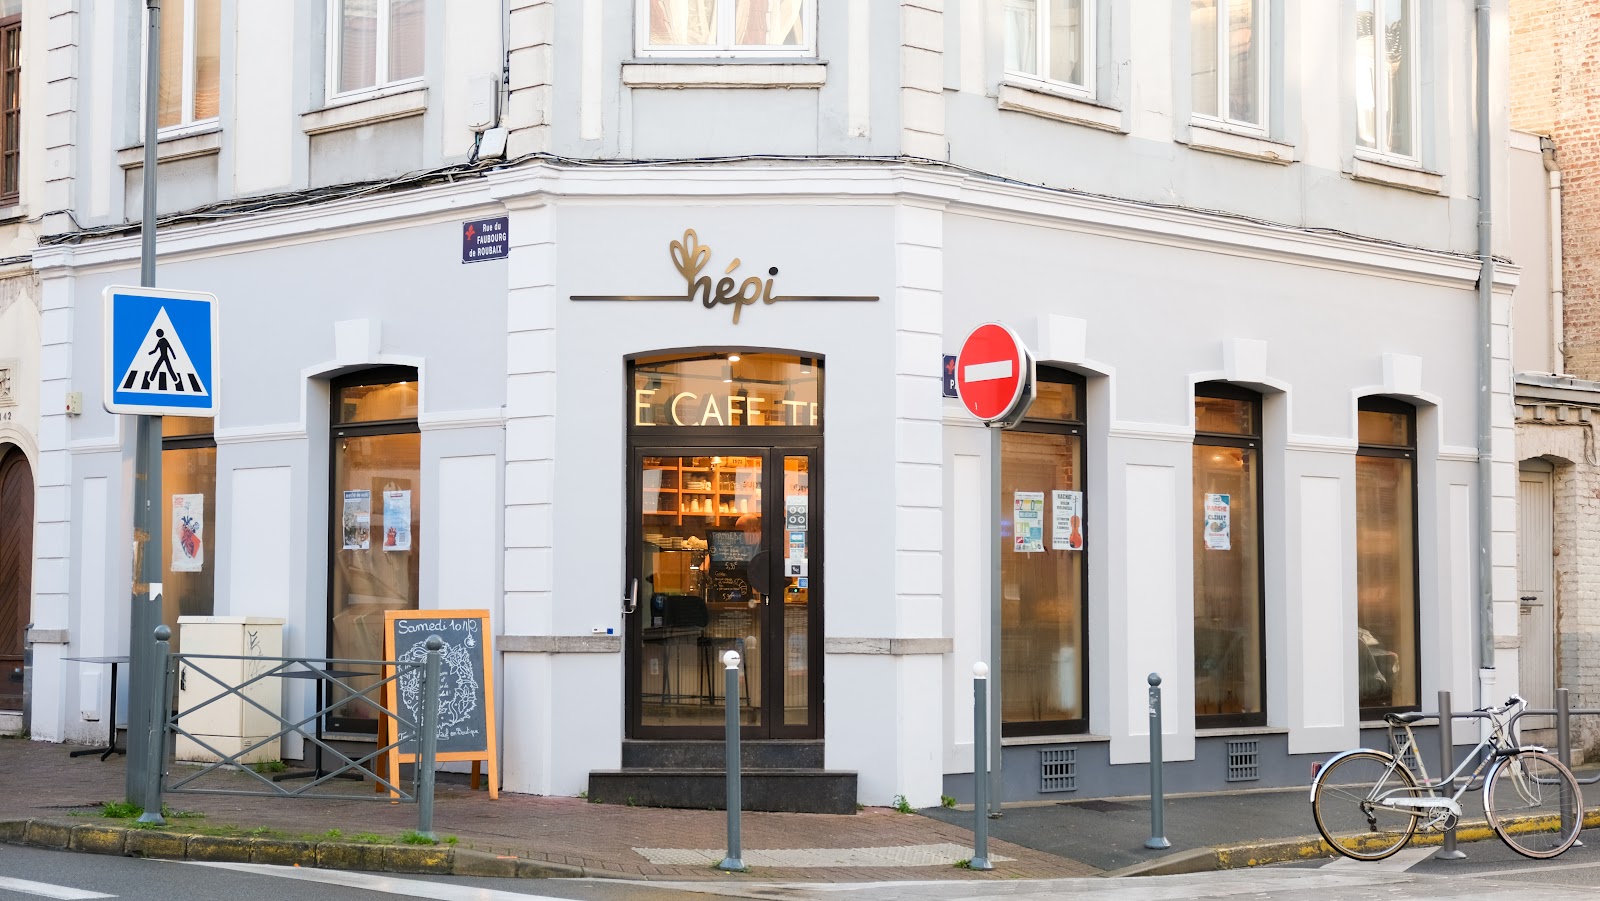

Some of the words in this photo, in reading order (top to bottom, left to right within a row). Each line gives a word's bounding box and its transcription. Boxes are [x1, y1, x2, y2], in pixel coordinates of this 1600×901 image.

[482, 223, 493, 233] Rue
[494, 221, 502, 231] du
[476, 232, 507, 245] FAUBOURG
[468, 248, 476, 258] de
[477, 244, 503, 257] ROUBAIX
[671, 391, 766, 426] CAFE
[398, 618, 447, 635] Samedi
